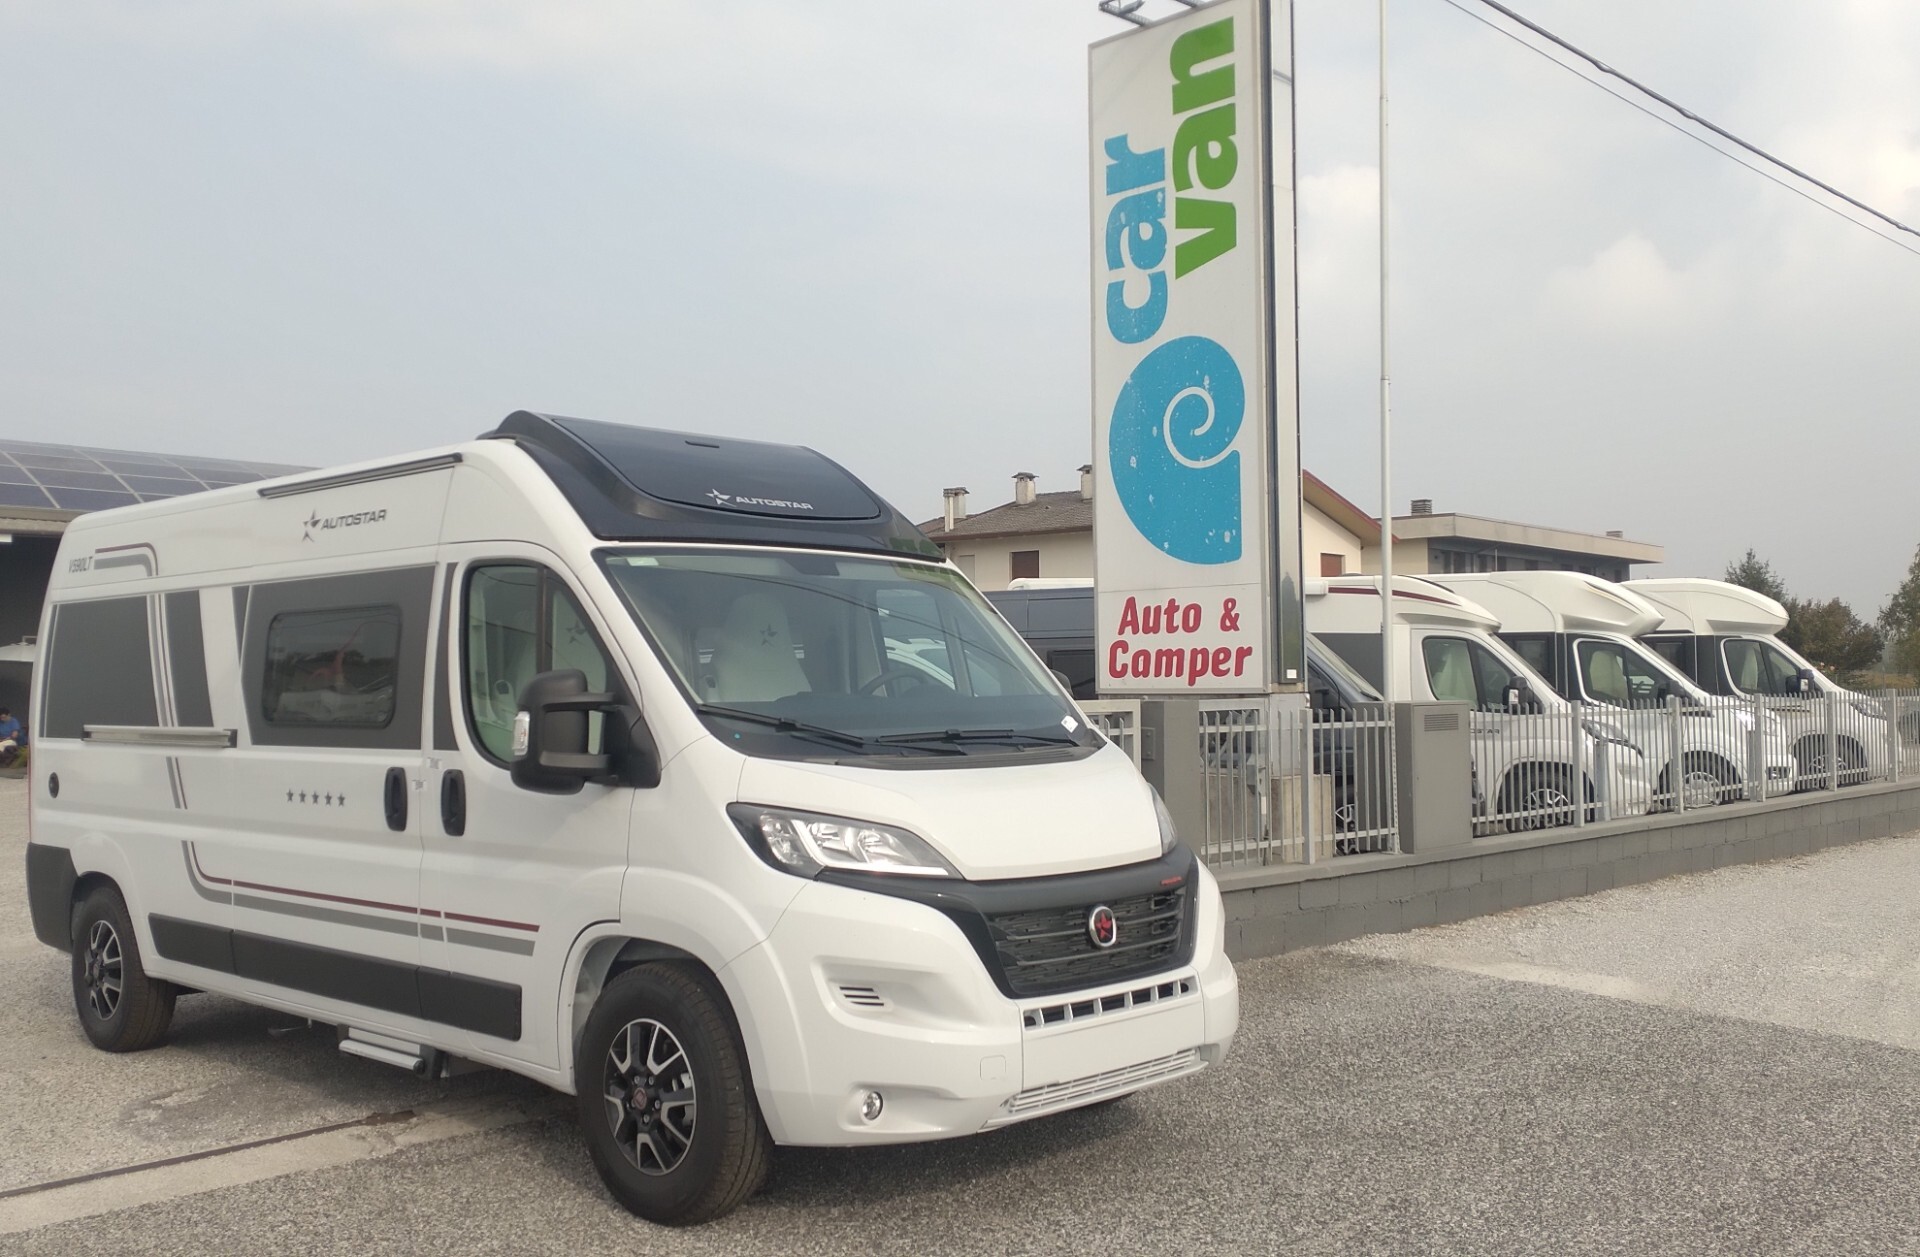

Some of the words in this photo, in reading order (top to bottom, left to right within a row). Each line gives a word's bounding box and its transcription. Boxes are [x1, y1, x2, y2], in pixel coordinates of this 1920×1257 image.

[1169, 16, 1238, 280] van
[1104, 133, 1169, 344] car
[321, 508, 387, 531] AUTOSTAR
[735, 496, 814, 510] AUTOSTAR
[1117, 596, 1203, 636] Auto
[1219, 597, 1241, 632] &
[1108, 639, 1253, 687] Camper
